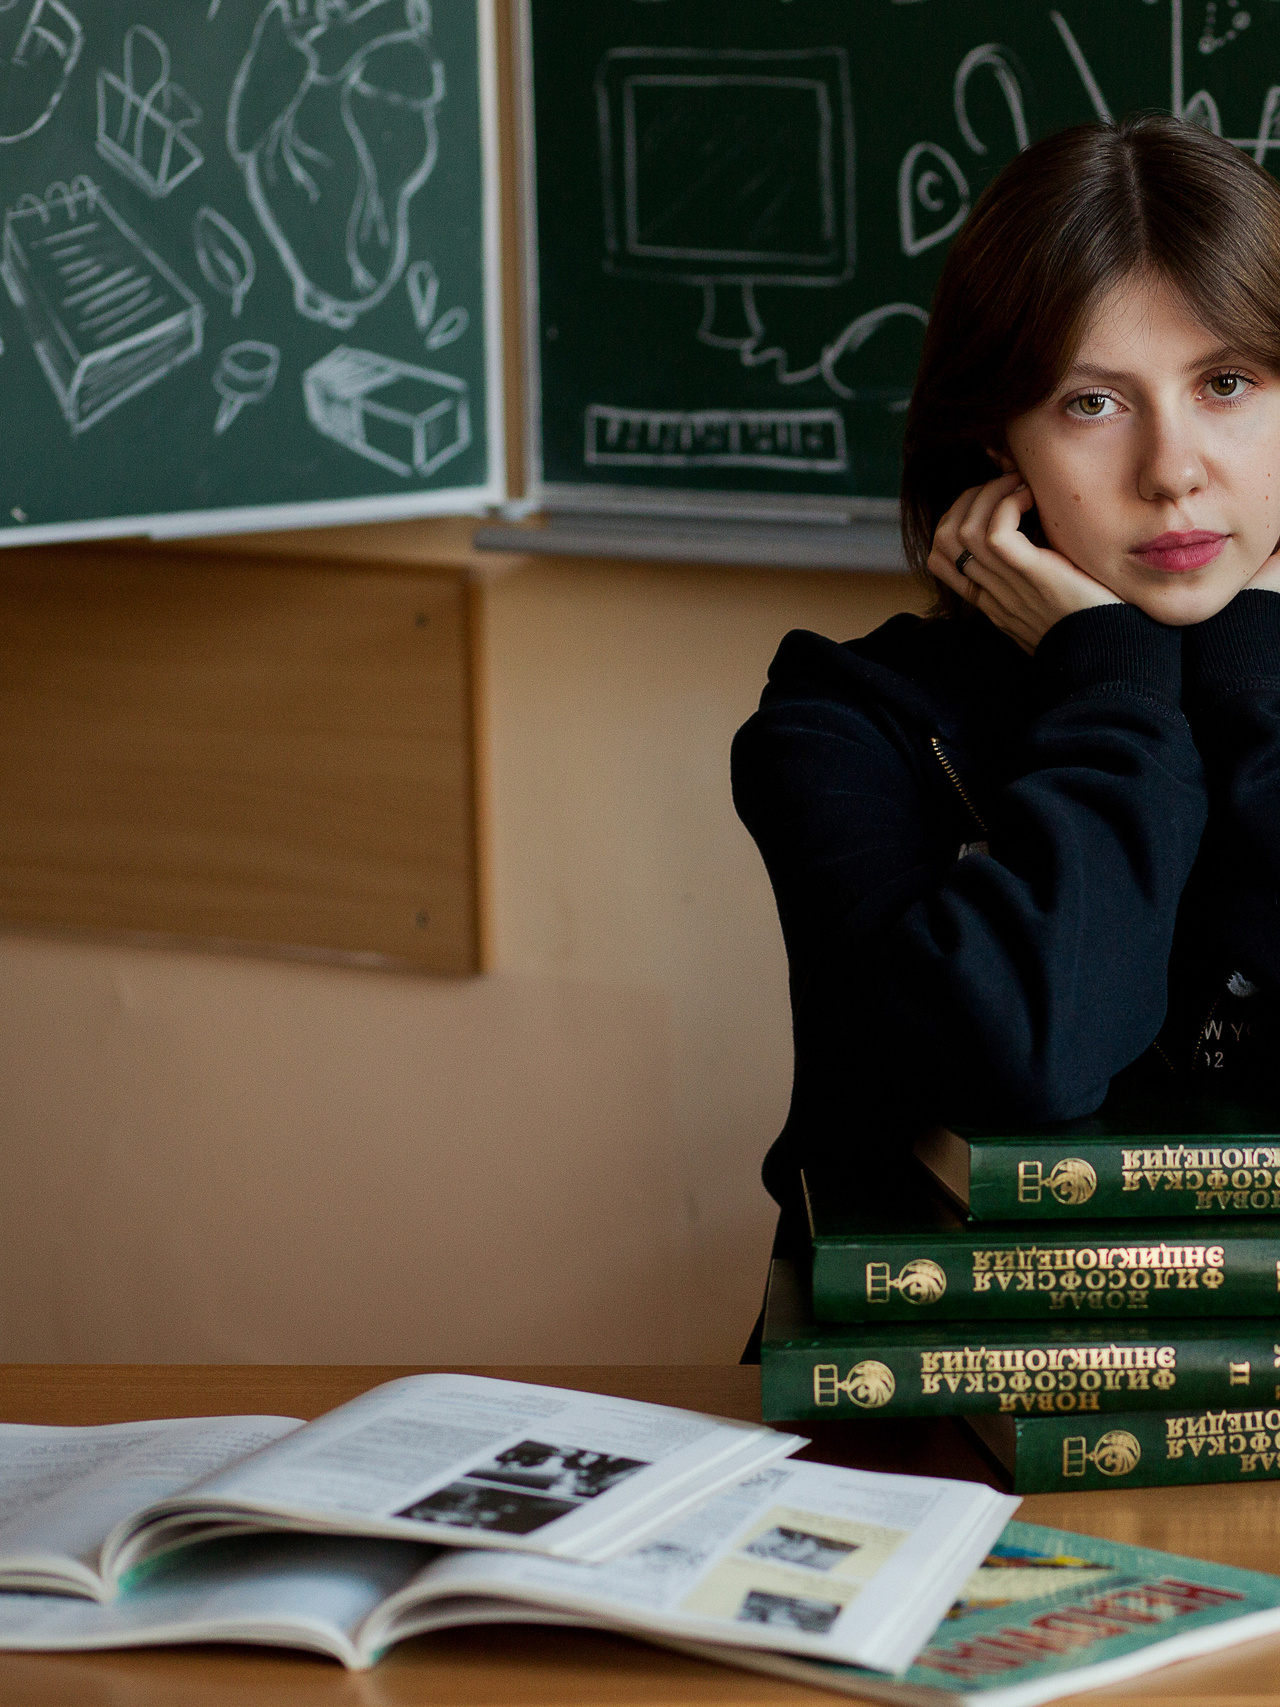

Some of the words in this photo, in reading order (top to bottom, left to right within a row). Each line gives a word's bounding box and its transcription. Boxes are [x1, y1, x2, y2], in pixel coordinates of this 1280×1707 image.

[972, 1243, 1225, 1271] ЭНЦИКЛОПЕДИЯ
[972, 1267, 1225, 1292] ФИЛОСОФСКАЯ
[1049, 1289, 1149, 1310] НОВАЯ
[921, 1344, 1176, 1373] ЭНЦИКЛОПЕДИЯ
[921, 1369, 1176, 1394] ФИЛОСОФСКАЯ
[1229, 1361, 1250, 1385] II
[999, 1392, 1100, 1412] НОВАЯ
